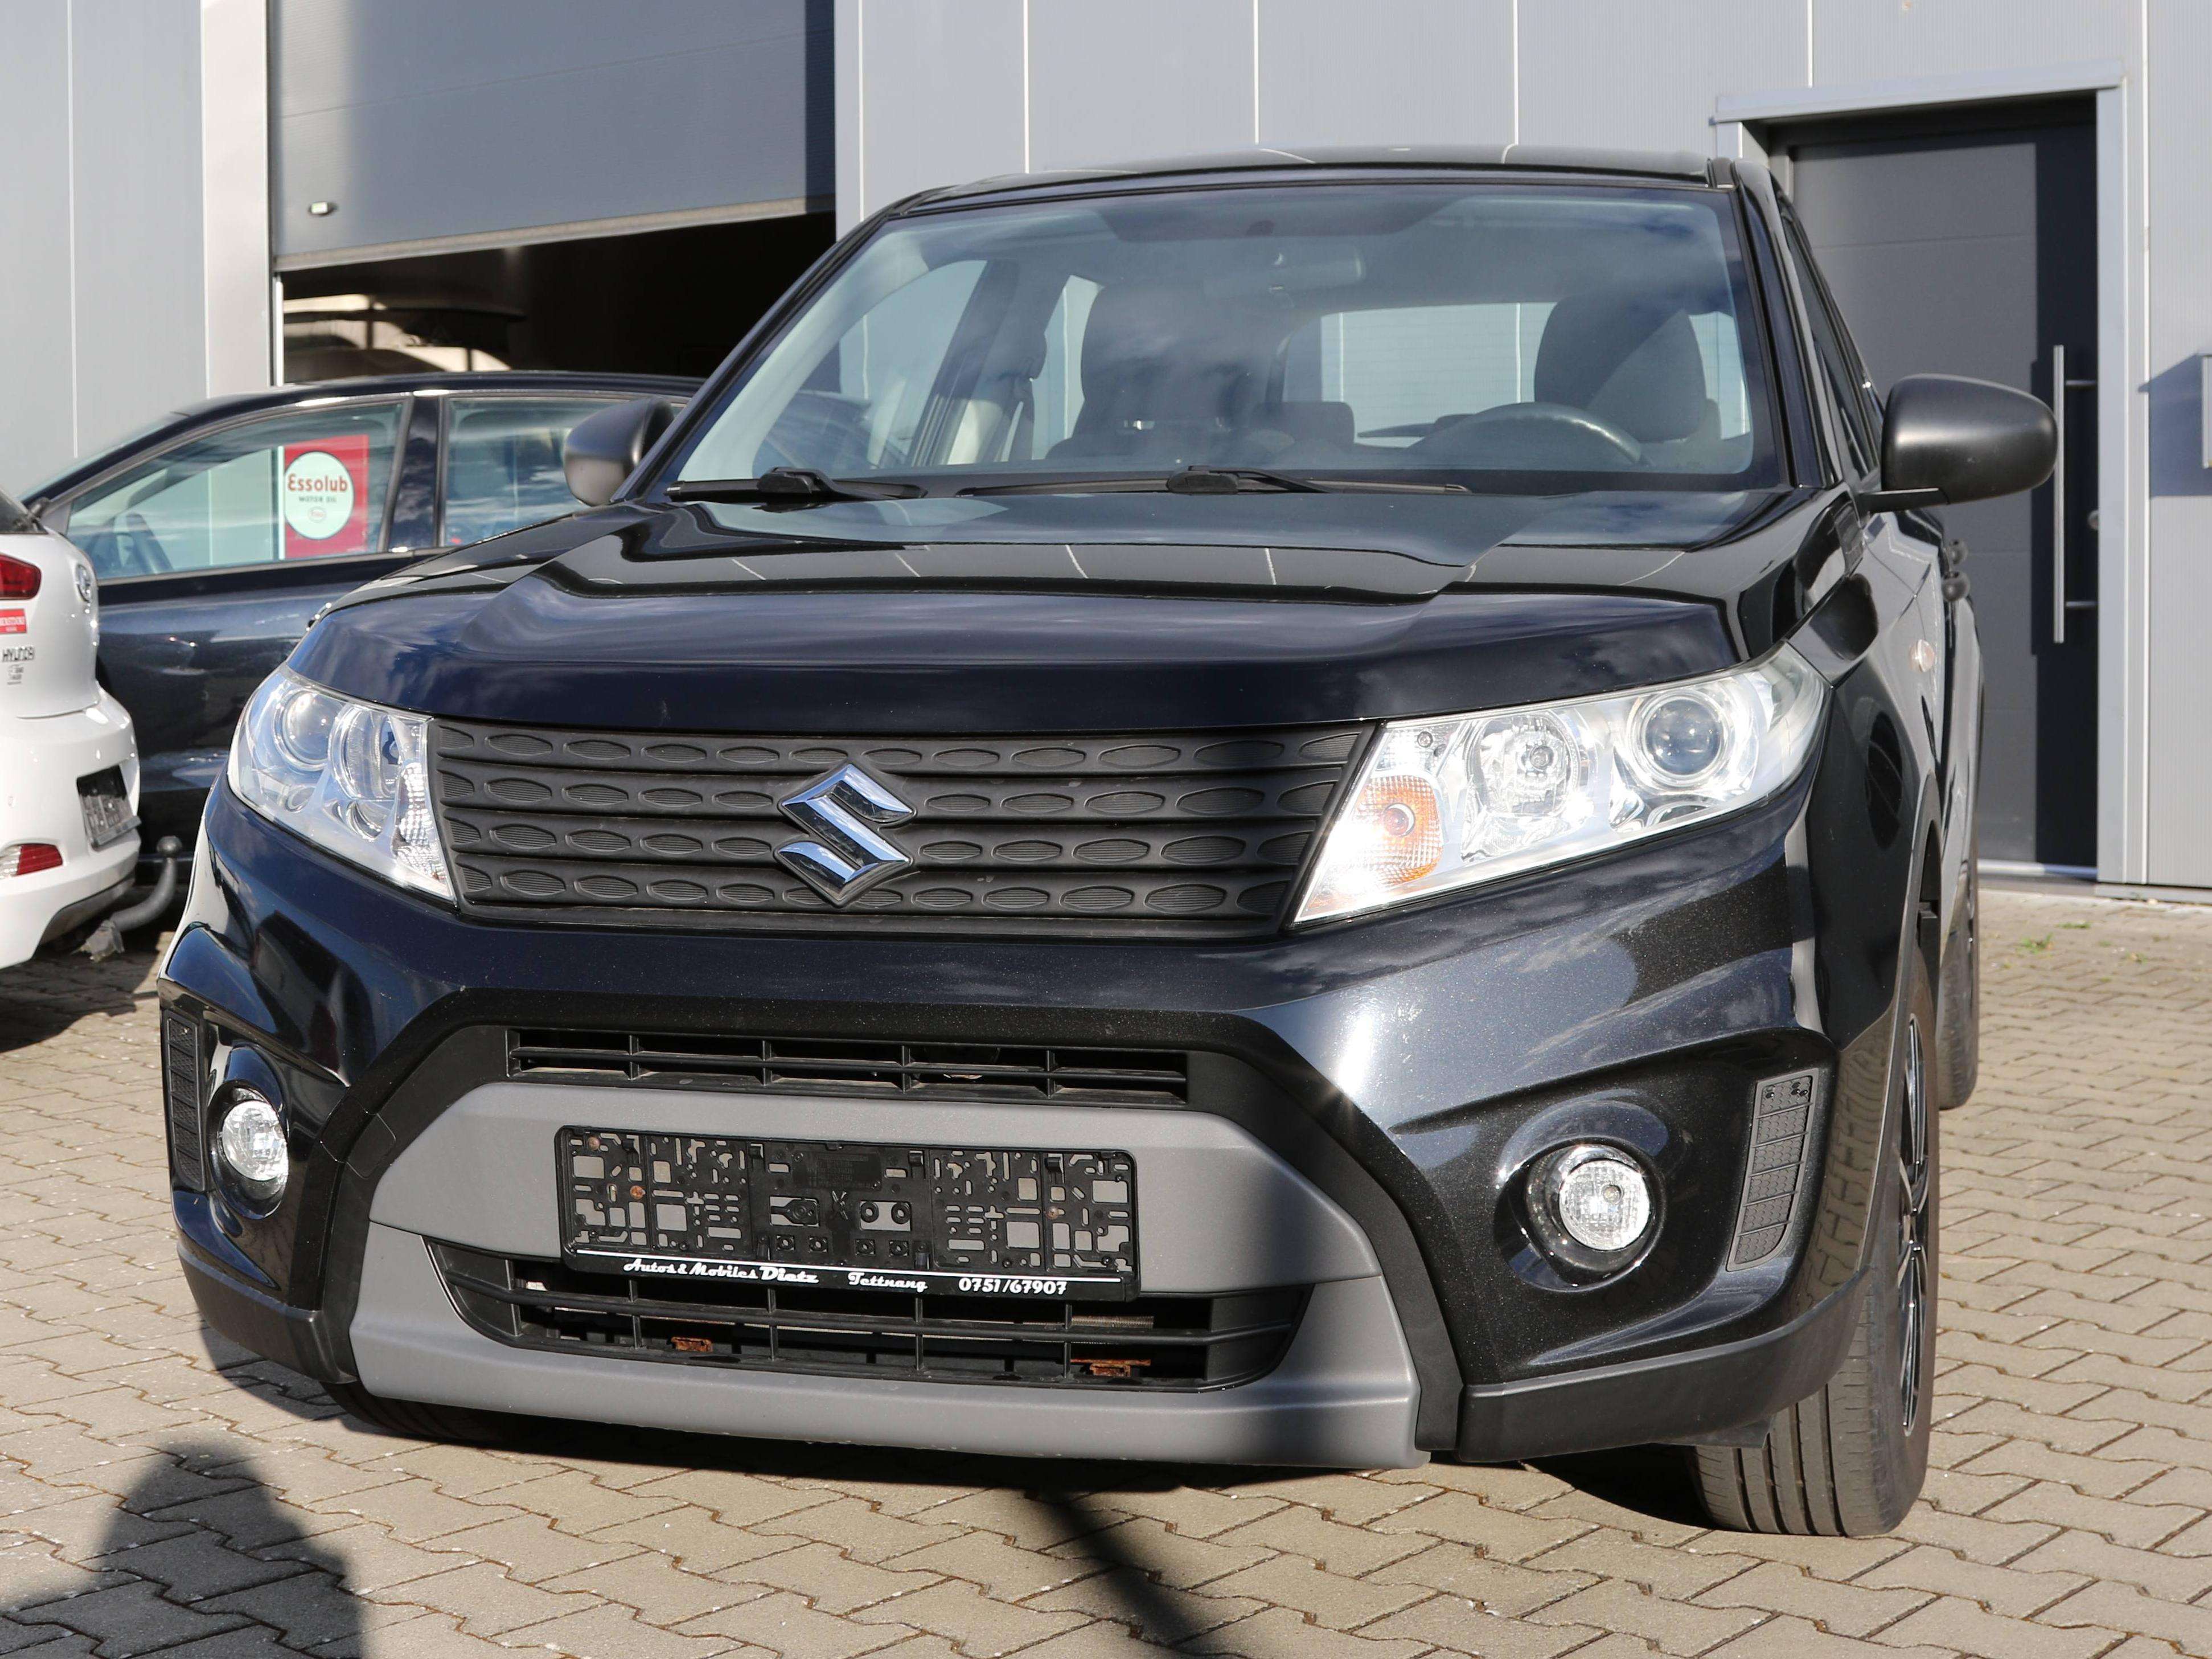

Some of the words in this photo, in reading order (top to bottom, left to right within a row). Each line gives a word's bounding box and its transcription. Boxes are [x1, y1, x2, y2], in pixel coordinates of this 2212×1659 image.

[288, 473, 348, 491] Essolub
[688, 1261, 759, 1279] Mobiles
[760, 1265, 819, 1283] Dietz
[847, 1271, 928, 1293] Tettnang
